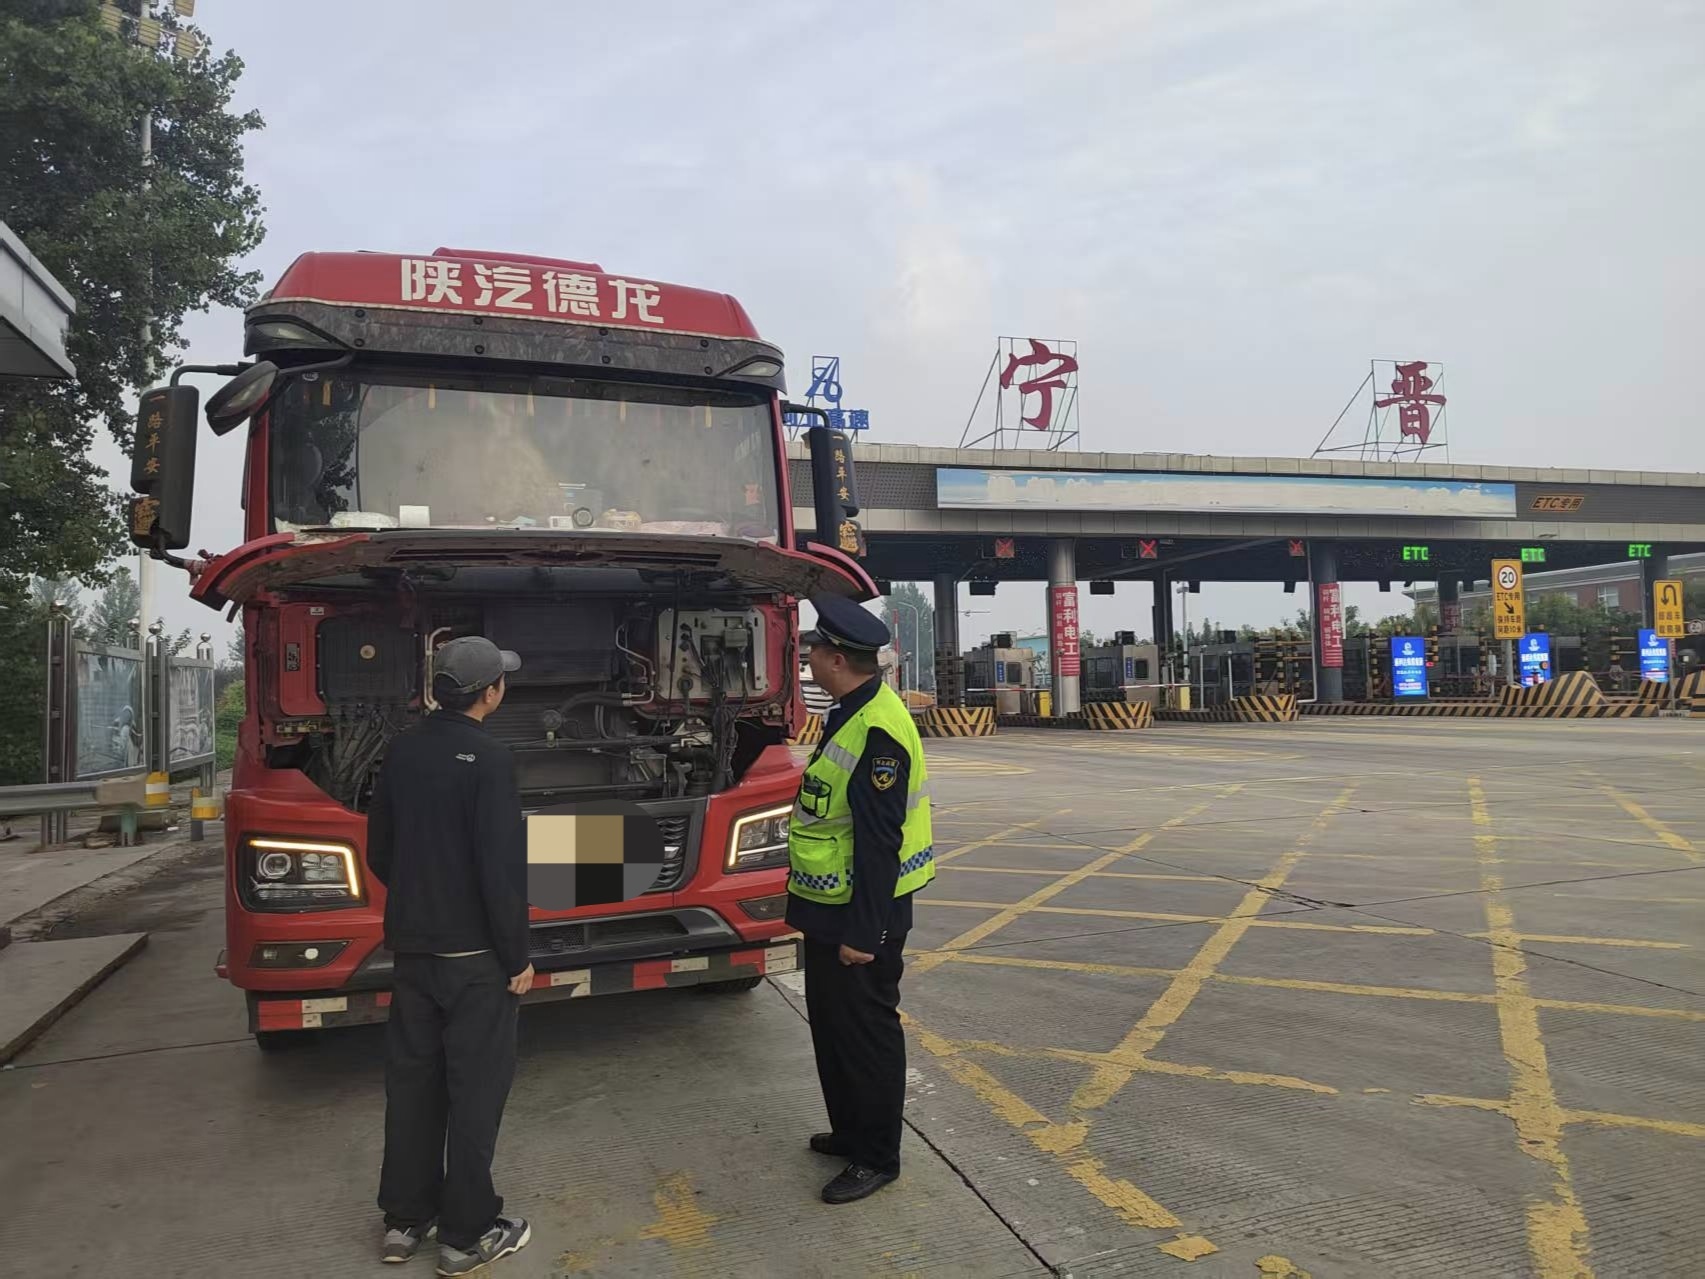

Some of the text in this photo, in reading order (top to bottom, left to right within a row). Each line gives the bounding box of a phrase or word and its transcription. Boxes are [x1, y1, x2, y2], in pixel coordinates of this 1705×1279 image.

[401, 258, 665, 325] 陕汽德龙
[999, 338, 1079, 431] 宁
[832, 435, 850, 502] 一路平安
[1403, 546, 1429, 561] ETC
[1521, 548, 1546, 562] ETC
[1628, 544, 1651, 558] ETC
[1501, 571, 1515, 583] 20
[1496, 592, 1521, 601] ETC专用
[1062, 591, 1077, 656] 富利电工
